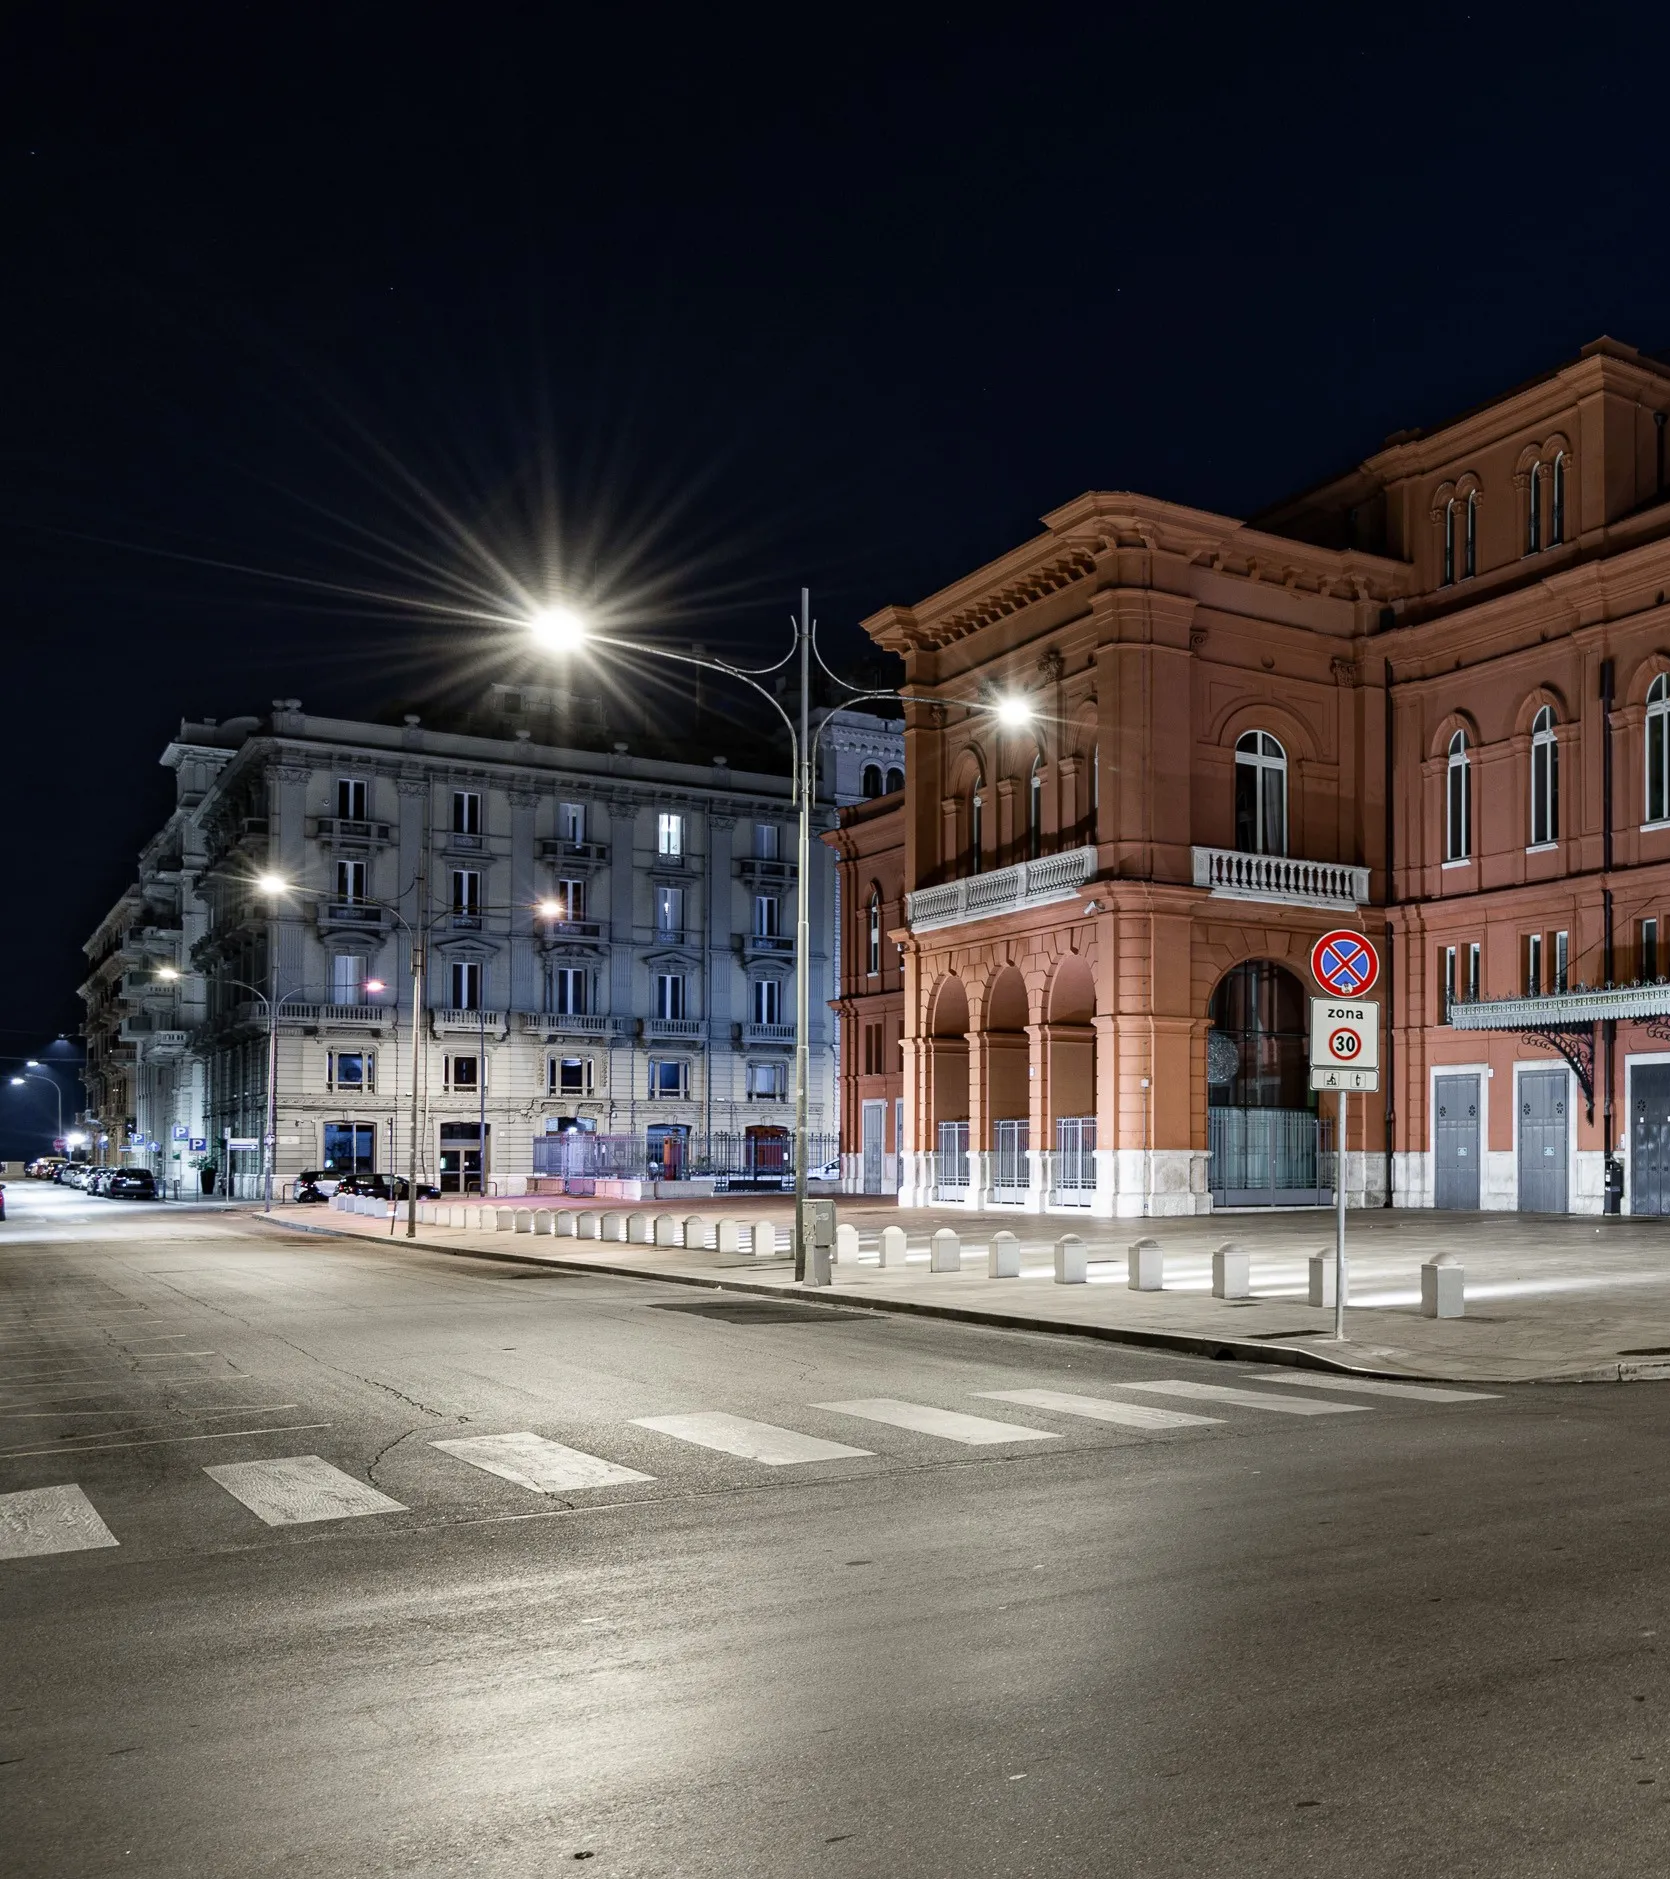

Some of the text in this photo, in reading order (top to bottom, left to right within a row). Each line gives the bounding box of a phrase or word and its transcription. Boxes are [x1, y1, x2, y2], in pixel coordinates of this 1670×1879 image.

[1327, 1008, 1364, 1020] zona
[1335, 1035, 1356, 1052] 30
[175, 1127, 187, 1138] P
[134, 1134, 142, 1143] P
[192, 1139, 204, 1150] P
